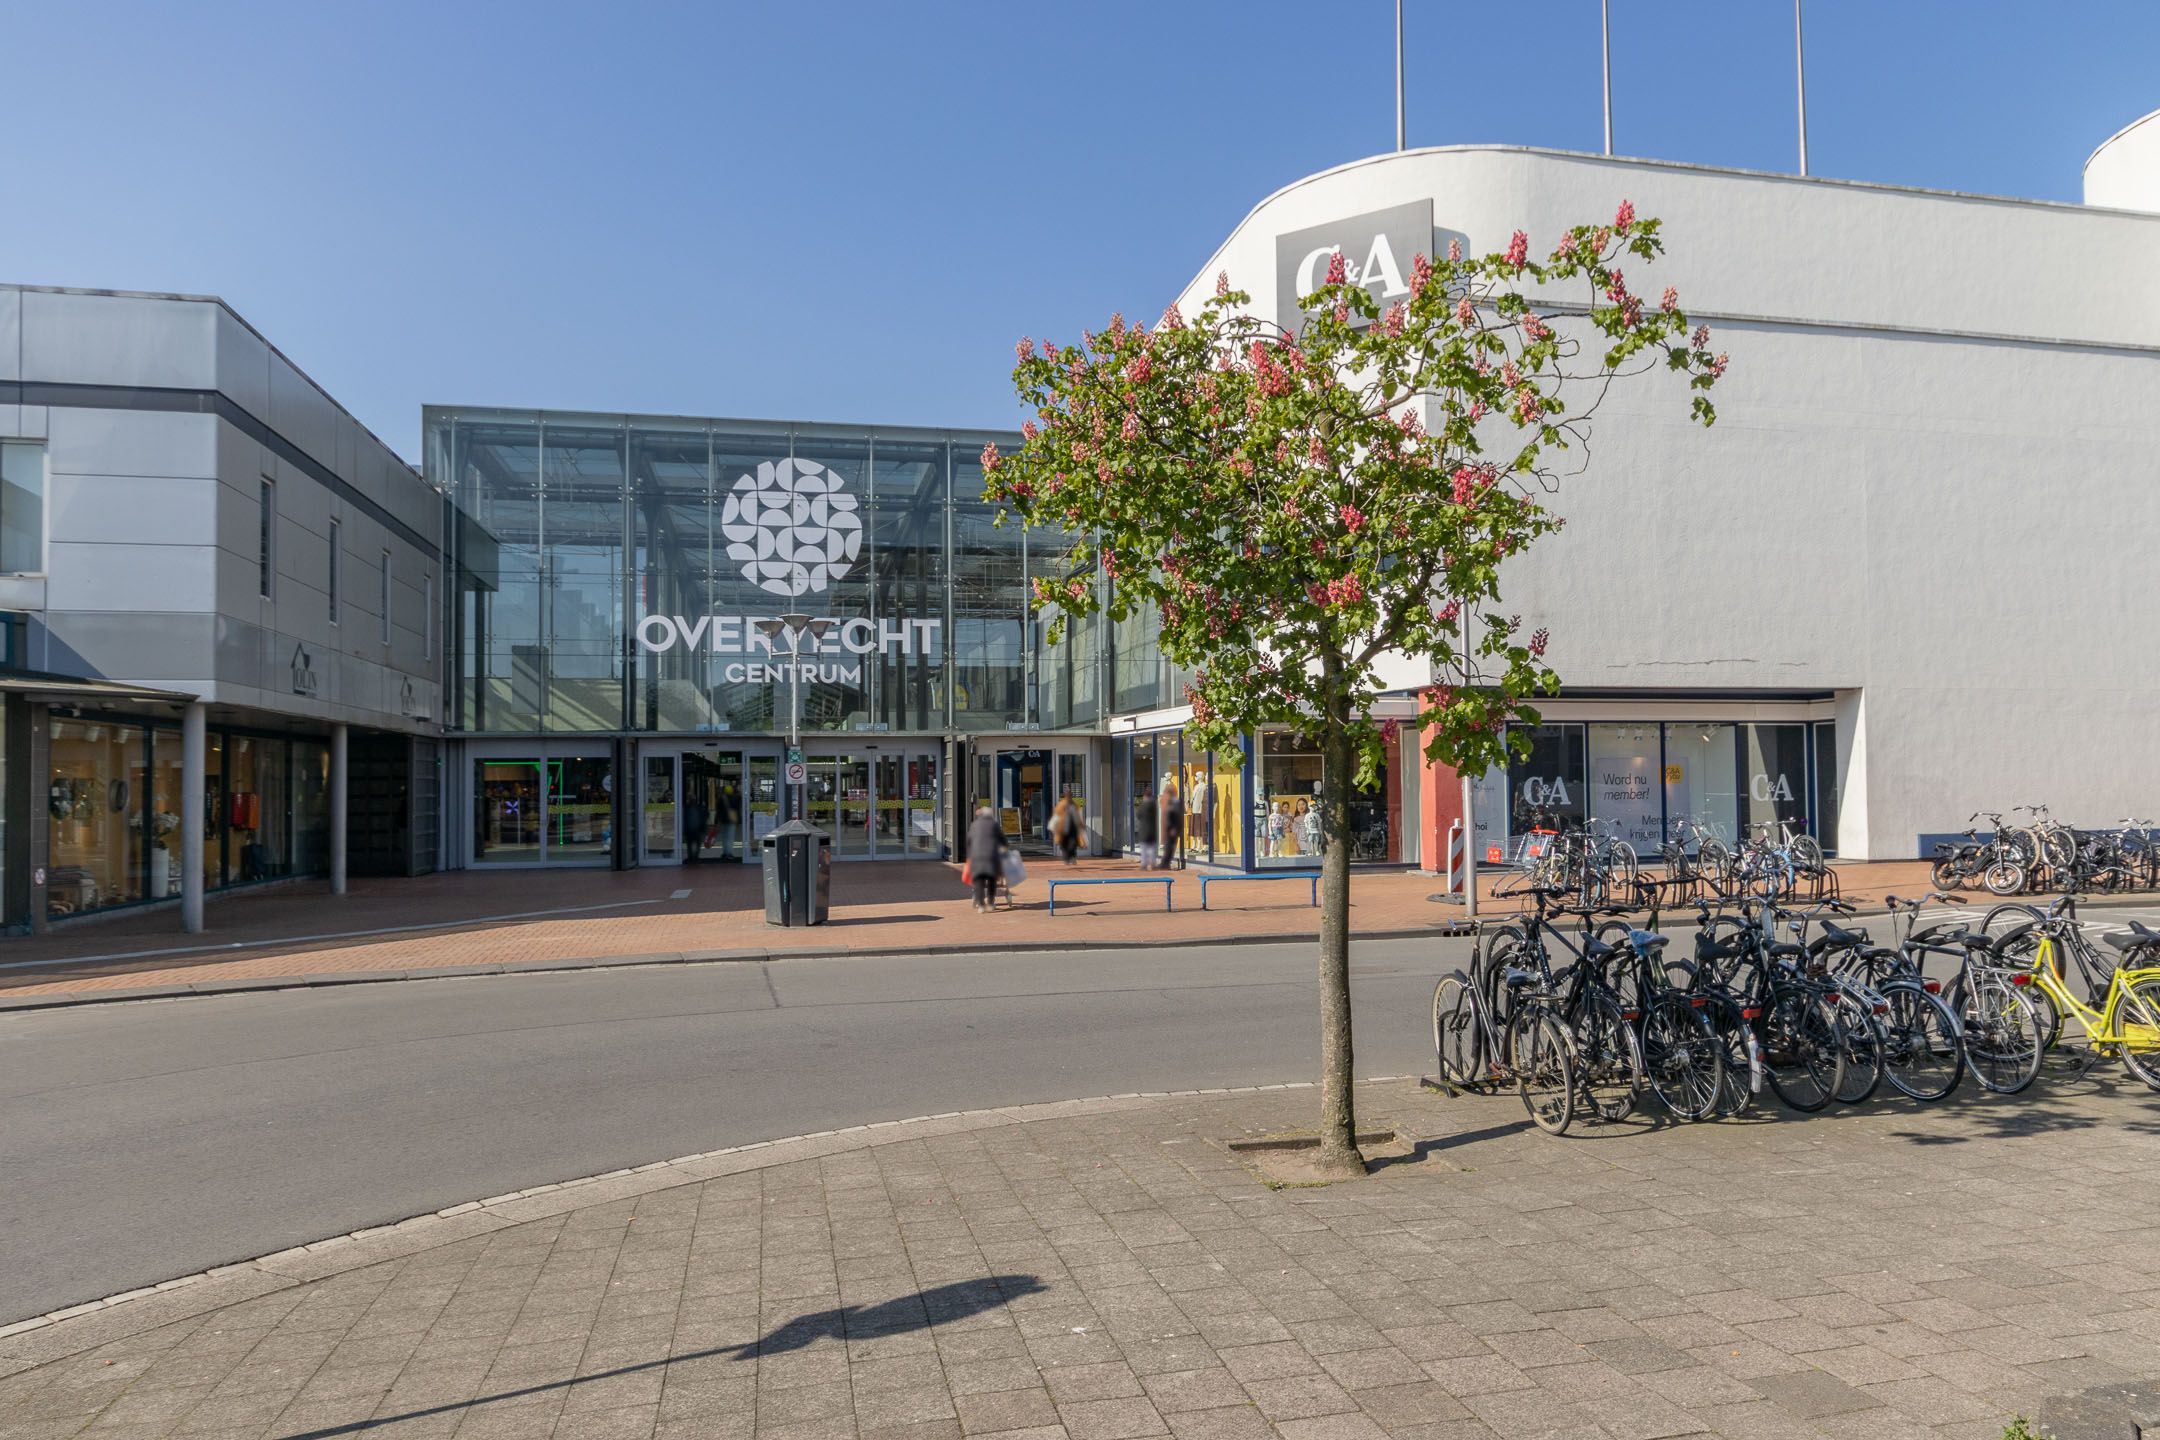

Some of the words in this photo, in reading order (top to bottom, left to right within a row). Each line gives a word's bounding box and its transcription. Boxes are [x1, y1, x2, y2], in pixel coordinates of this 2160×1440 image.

[1296, 233, 1410, 312] C&A
[636, 615, 941, 654] OVERVECHT
[725, 662, 861, 683] CENTRUM
[1523, 776, 1572, 806] C&A
[1603, 773, 1631, 785] Word
[1634, 775, 1647, 785] nu
[1751, 773, 1795, 802] C&A
[1603, 788, 1650, 801] member!
